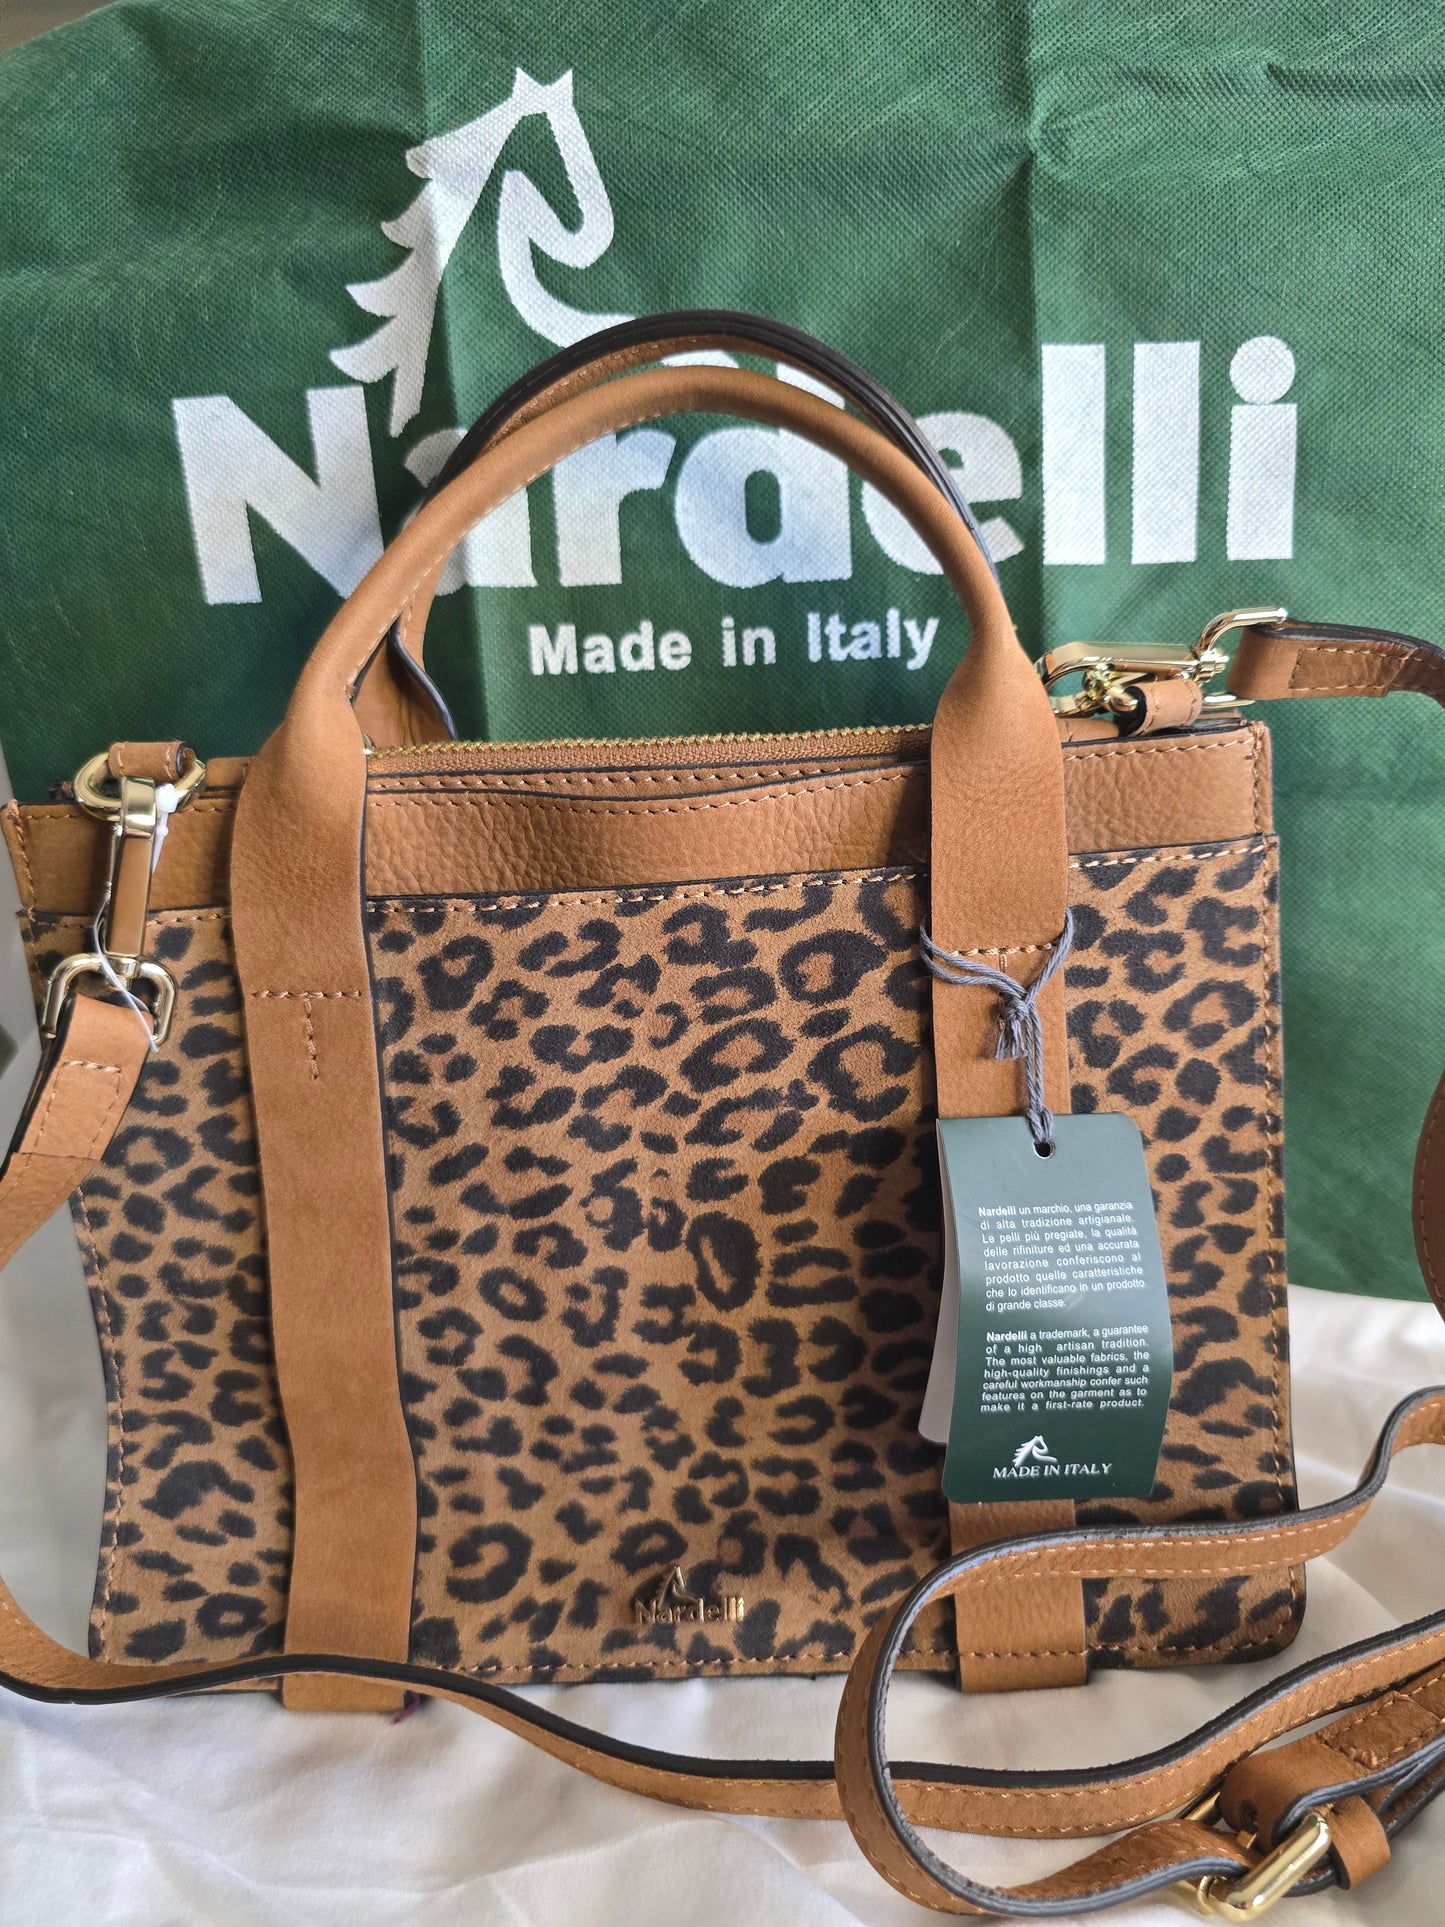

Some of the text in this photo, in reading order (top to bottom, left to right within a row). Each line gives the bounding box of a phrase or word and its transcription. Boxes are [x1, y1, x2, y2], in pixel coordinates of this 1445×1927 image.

[529, 607, 939, 675] Made in Italy
[978, 1206, 1016, 1217] Nardelli
[1019, 1207, 1030, 1215] un
[1075, 1204, 1092, 1212] una
[1094, 1200, 1133, 1213] garanzia
[981, 1220, 989, 1230] di
[996, 1220, 1015, 1229] alta
[1022, 1217, 1072, 1228] tradizione
[982, 1234, 994, 1244] Le
[1000, 1232, 1020, 1244] pelli
[1025, 1231, 1040, 1243] più
[1091, 1228, 1100, 1237] la
[1105, 1226, 1137, 1238] qualità
[984, 1240, 1139, 1257] delle rifiniture ed una accurata
[984, 1252, 1141, 1271] lavorazione conferiscono al
[986, 1266, 1143, 1286] prodotto quelle caratteristiche
[986, 1279, 1145, 1298] che lo identificano in un prodotto
[986, 1299, 1066, 1312] di grande classe.
[986, 1331, 1027, 1342] Nardelli
[1030, 1332, 1036, 1340] a
[1093, 1328, 1100, 1336] a
[1102, 1325, 1148, 1337] guarantee
[986, 1338, 1148, 1354] of a high artisan tradition.
[986, 1357, 1006, 1367] The
[1011, 1356, 1036, 1365] most
[1042, 1354, 1085, 1364] valuable
[1134, 1350, 1149, 1360] the
[984, 1368, 1049, 1379] high-quality
[1057, 1366, 1109, 1376] finishings
[1116, 1364, 1136, 1373] and
[983, 1375, 1148, 1389] careful workmanship confer such
[982, 1391, 1025, 1401] features
[1049, 1390, 1065, 1399] the
[1071, 1389, 1114, 1399] garment
[1119, 1388, 1131, 1396] as
[1137, 1388, 1147, 1396] to
[981, 1403, 1010, 1412] make
[1017, 1402, 1024, 1410] it
[1046, 1400, 1093, 1409] first-rate
[1100, 1399, 1144, 1409] product.
[993, 1463, 1112, 1478] MADE IN ITALY
[636, 1597, 744, 1624] Nardelli
